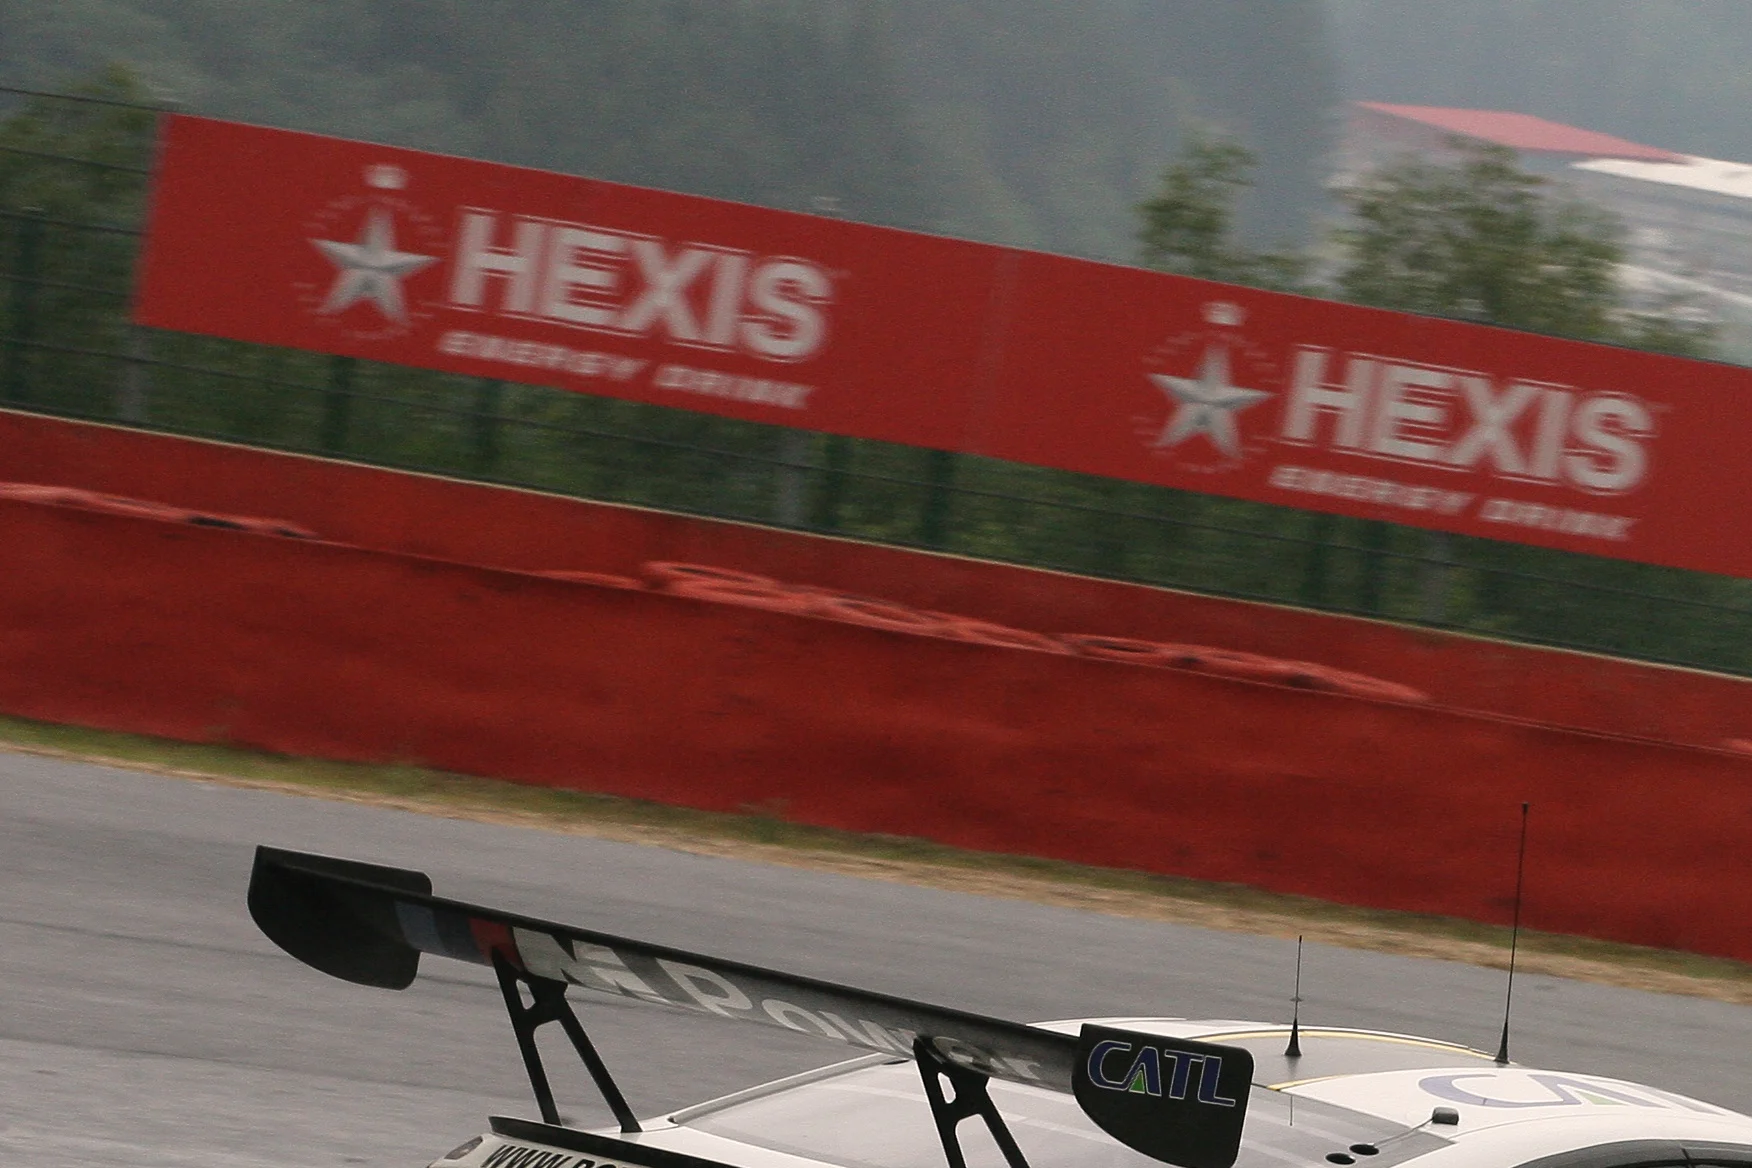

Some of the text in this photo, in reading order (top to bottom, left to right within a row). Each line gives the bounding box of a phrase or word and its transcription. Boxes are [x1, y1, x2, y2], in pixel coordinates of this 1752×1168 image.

[448, 205, 835, 363] HEXIS
[438, 330, 816, 410] ENERGY DRINK
[1280, 344, 1657, 495] HEXIS
[1267, 465, 1641, 541] ENERGY DRINK
[1087, 1037, 1237, 1110] CATL
